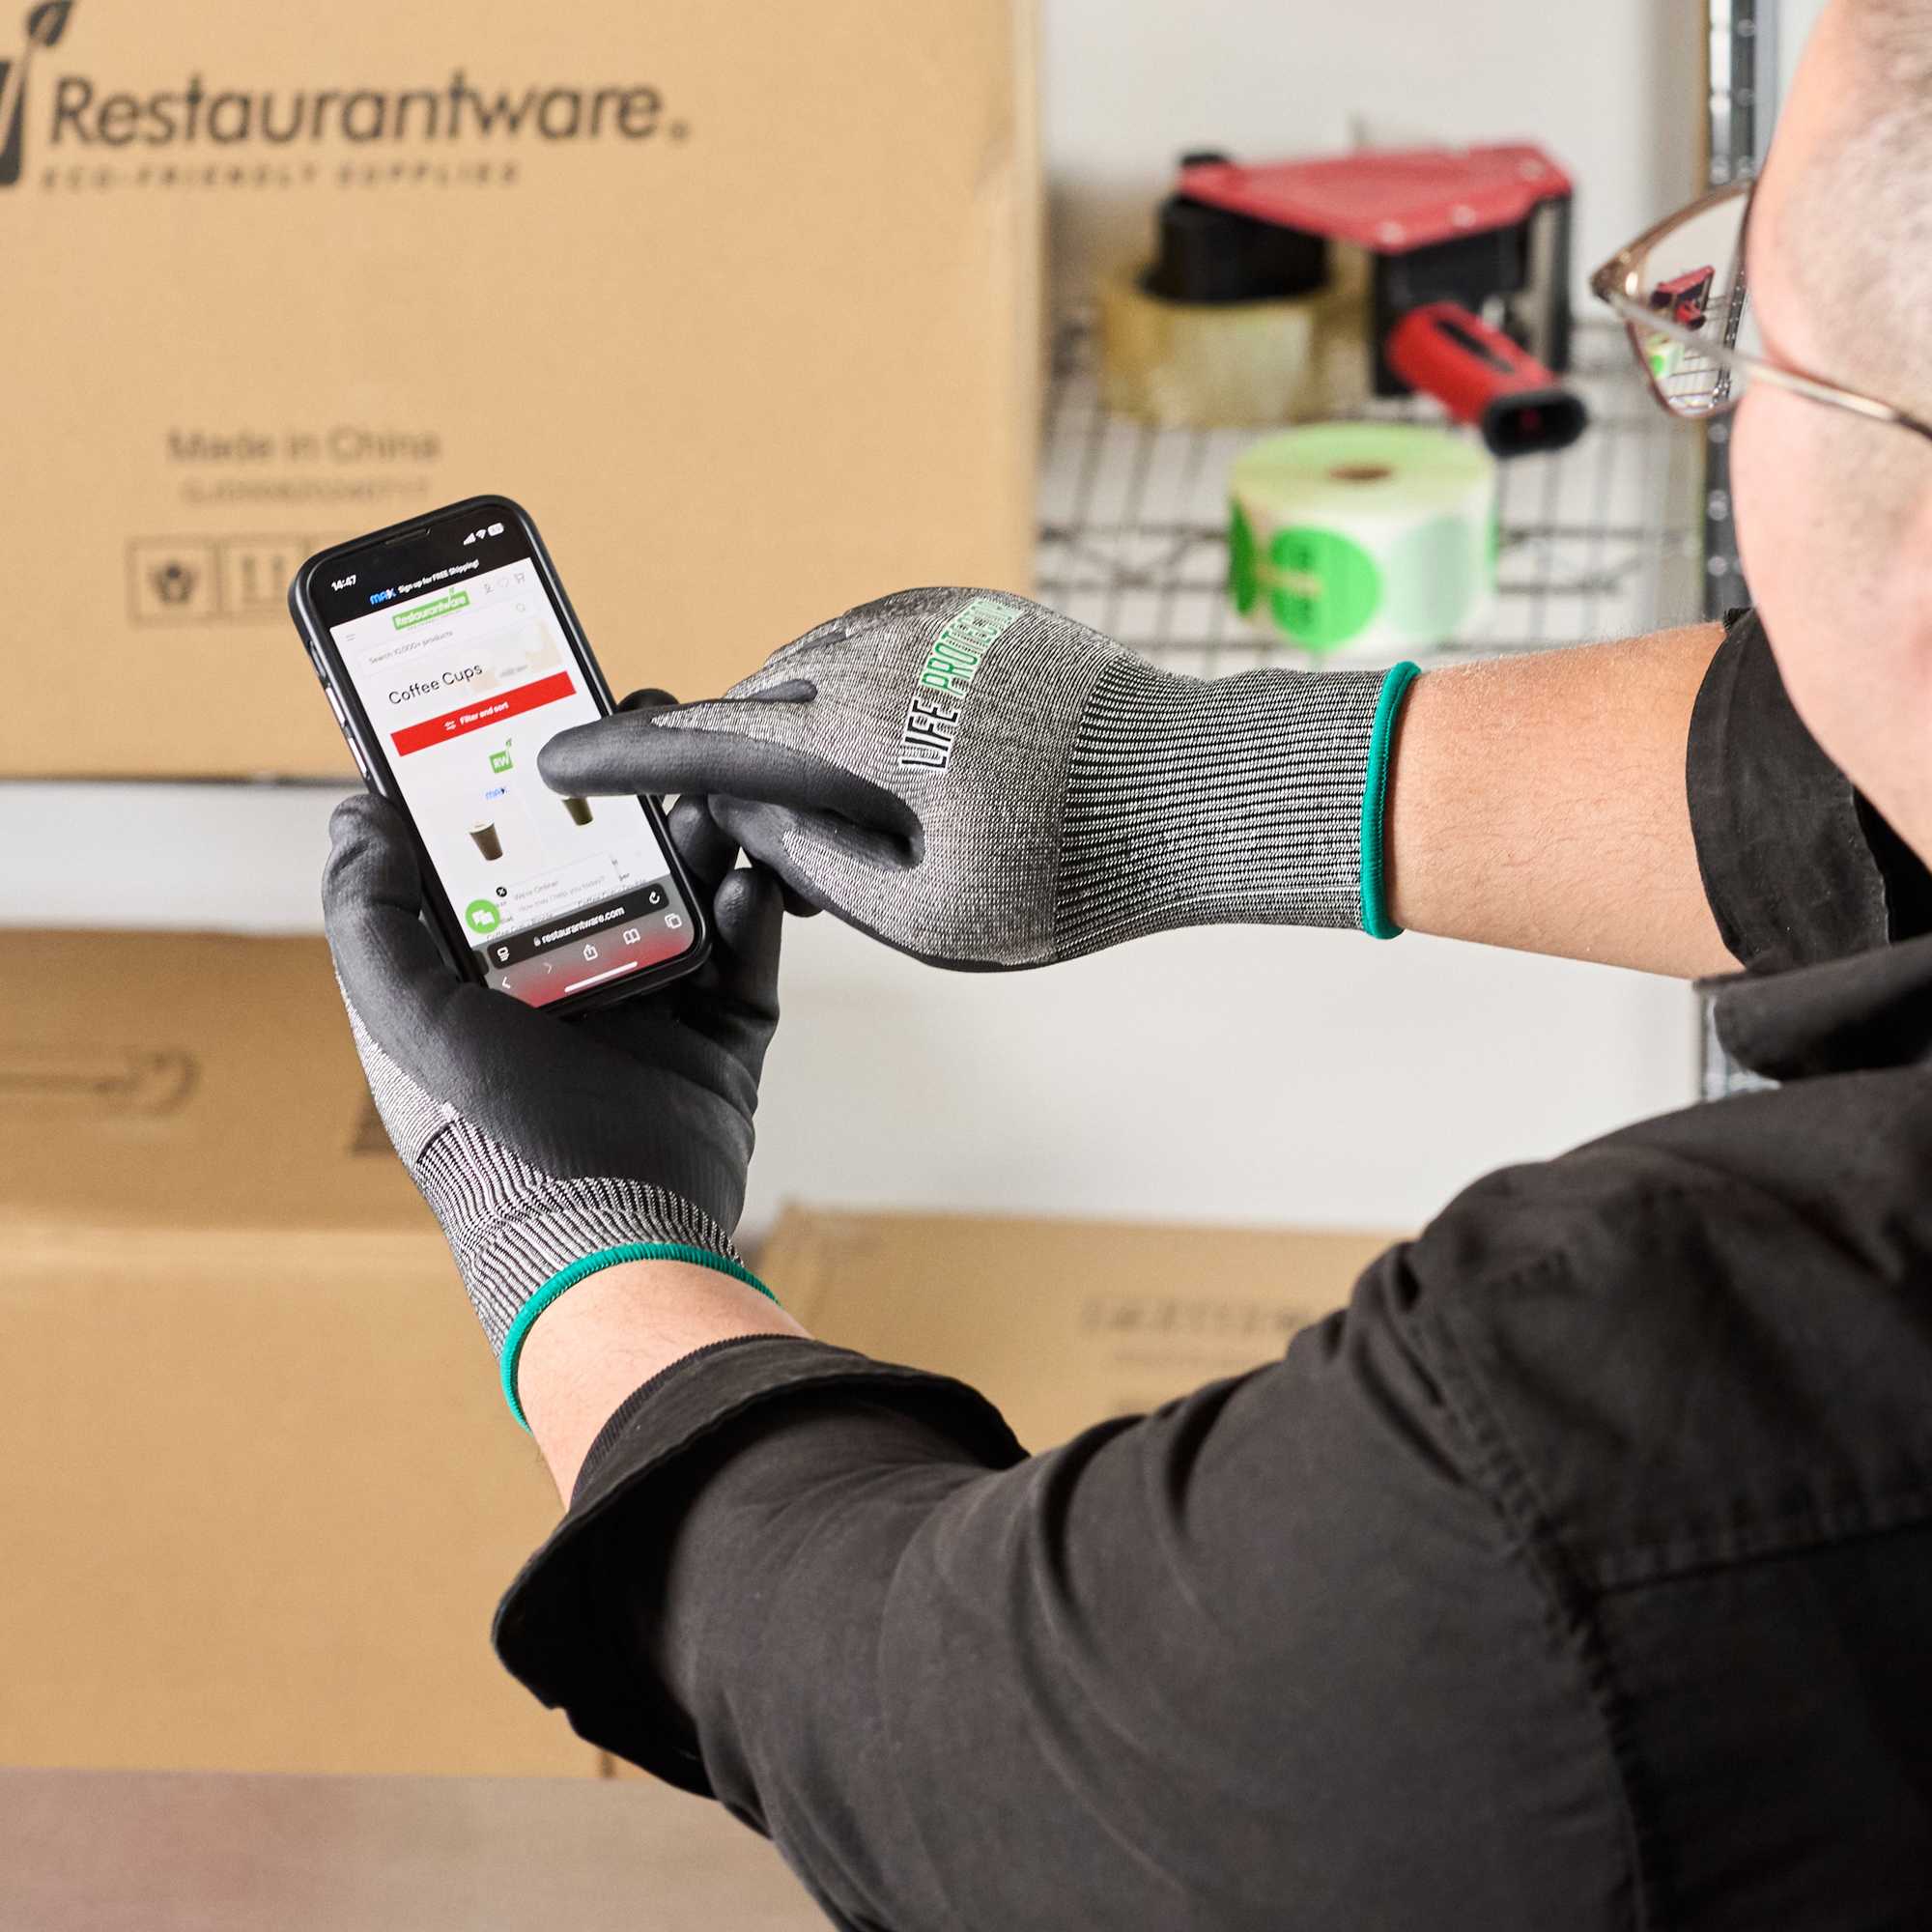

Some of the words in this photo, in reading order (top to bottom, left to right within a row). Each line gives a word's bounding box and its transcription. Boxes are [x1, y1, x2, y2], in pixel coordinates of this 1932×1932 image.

[331, 574, 357, 591] 14:47
[432, 569, 449, 582] FREE
[920, 597, 1022, 697] PROTEC
[388, 680, 440, 704] Coffee
[441, 665, 483, 686] Cups
[459, 713, 479, 725] Filter
[479, 706, 494, 718] and
[494, 701, 510, 713] sort
[900, 697, 960, 770] LIFE
[541, 906, 625, 944] restaurantware.com
